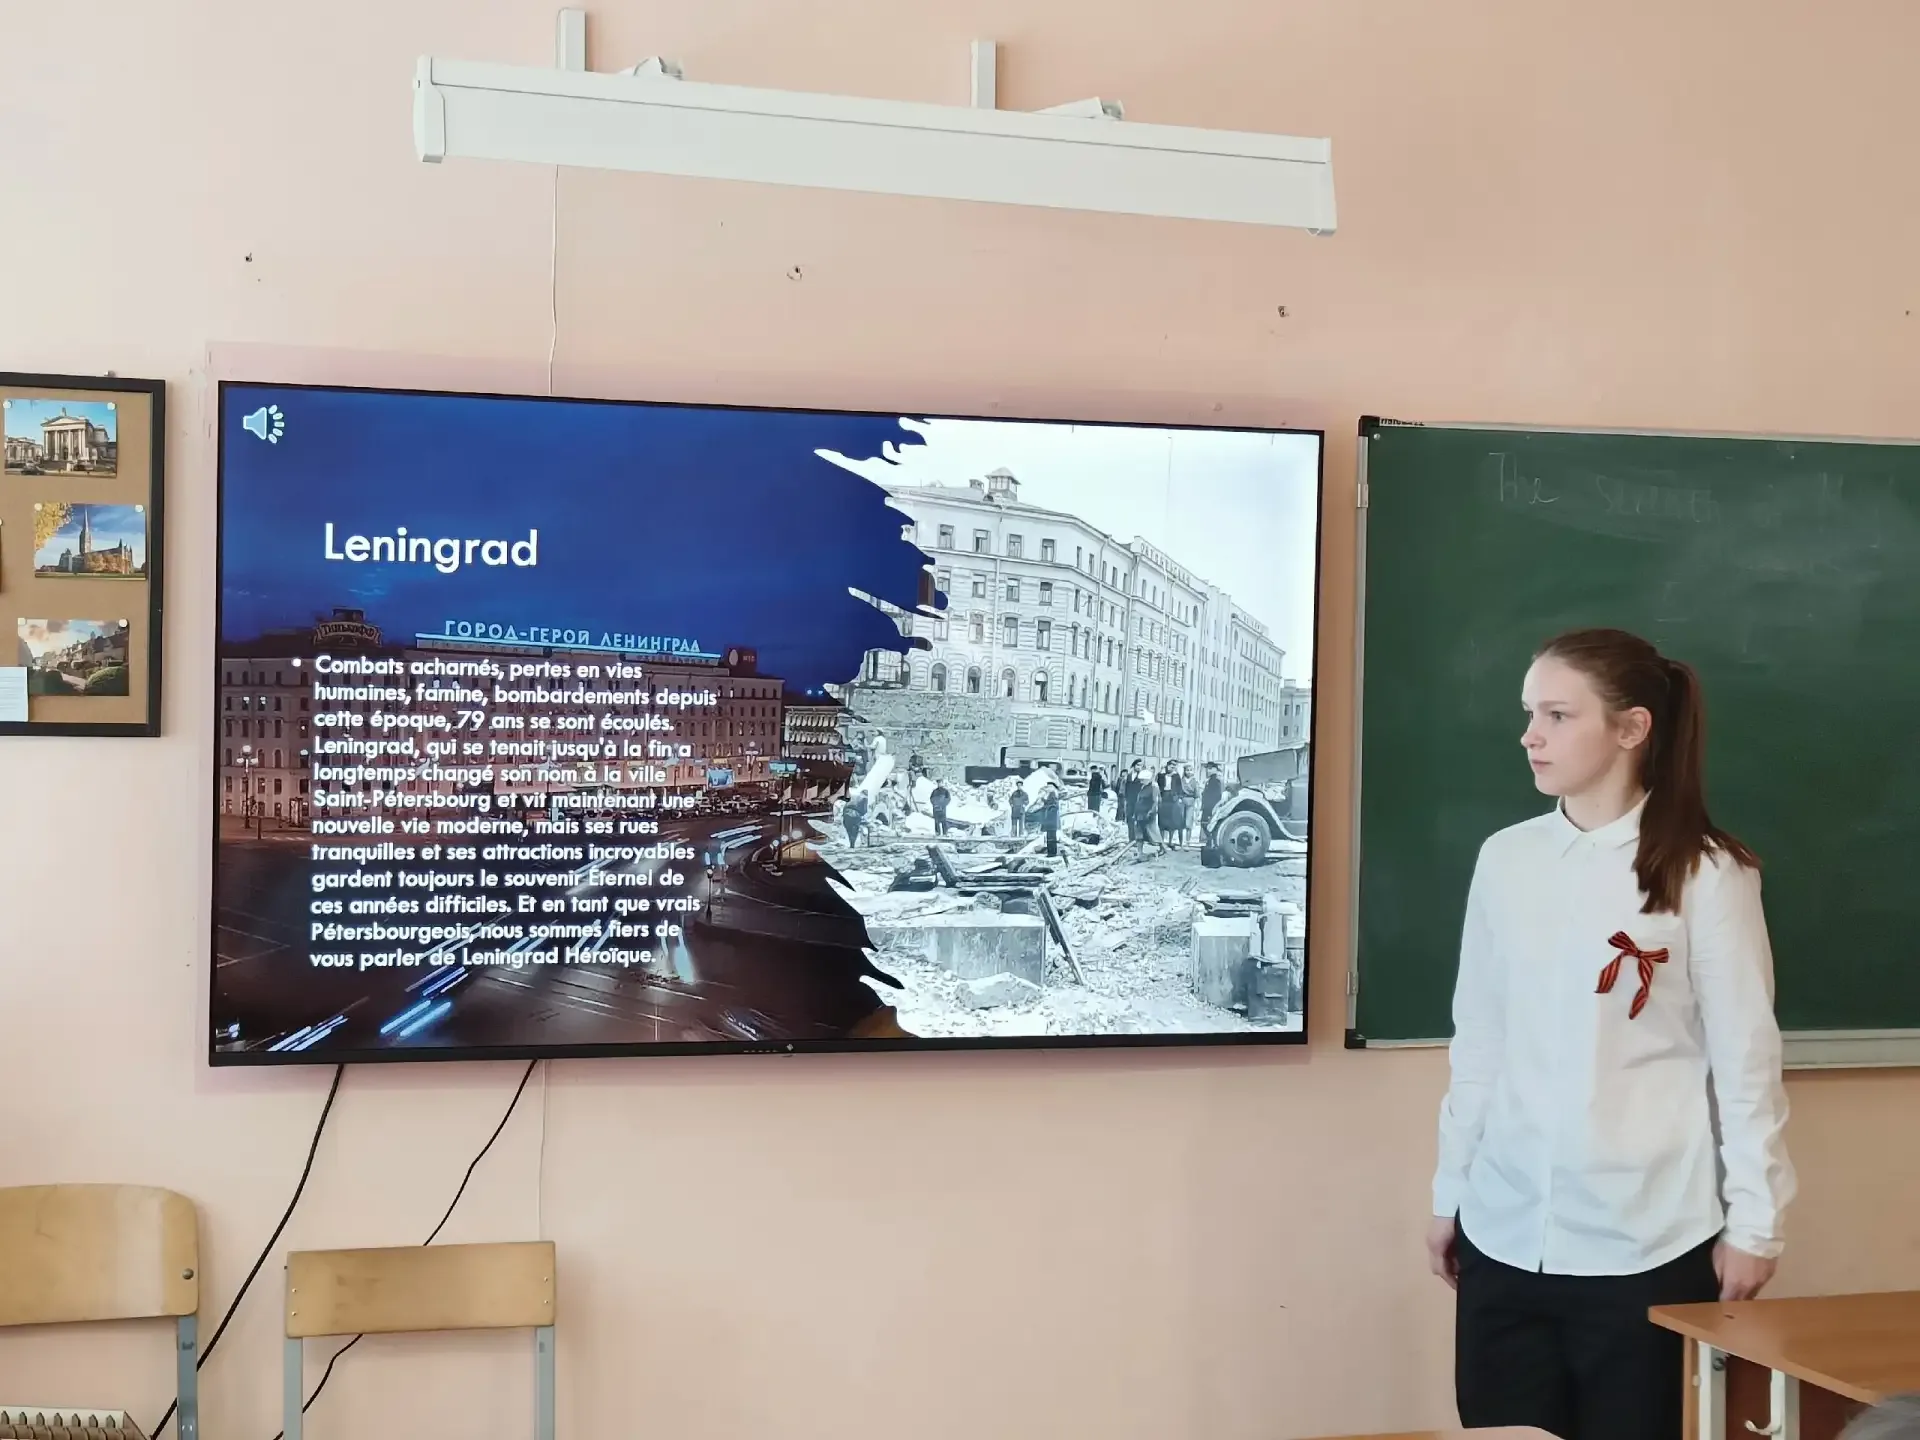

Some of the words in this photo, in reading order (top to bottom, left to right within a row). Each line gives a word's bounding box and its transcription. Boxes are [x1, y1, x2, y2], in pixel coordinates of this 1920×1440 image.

[324, 522, 538, 574] Leningrad
[444, 620, 590, 646] ГОРОД-ГЕРОЙ
[600, 632, 701, 653] ЛЕНИНГРАД
[315, 655, 404, 674] Combats
[411, 657, 504, 680] acharnés,
[510, 661, 571, 681] pertes
[577, 665, 600, 678] en
[606, 663, 642, 679] vies
[314, 682, 411, 705] humaines,
[416, 683, 488, 706] famine,
[494, 686, 650, 705] bombardements
[656, 688, 717, 710] depuis
[313, 711, 363, 727] cette
[370, 711, 451, 732] époque,
[456, 711, 485, 729] 79
[491, 715, 524, 729] ans
[530, 716, 551, 730] se
[557, 714, 595, 730] sont
[601, 713, 675, 731] écoulés.
[314, 736, 420, 759] Leningrad,
[427, 739, 457, 759] qui
[463, 742, 483, 755] se
[489, 740, 546, 756] tenait
[551, 737, 617, 760] jusqu'à
[624, 740, 641, 756] la
[648, 740, 672, 756] fin
[679, 744, 691, 757] a
[313, 763, 416, 785] longtemps
[422, 764, 494, 786] changé
[500, 768, 531, 781] son
[538, 768, 577, 782] nom
[584, 766, 596, 782] à
[604, 765, 621, 782] la
[628, 766, 667, 782] ville
[313, 790, 491, 812] Saint-Pétersbourg
[497, 793, 517, 807] et
[522, 792, 547, 808] vit
[552, 793, 656, 808] maintenant
[662, 795, 695, 808] une
[312, 816, 394, 834] nouvelle
[400, 817, 430, 833] vie
[437, 817, 529, 837] moderne,
[536, 818, 579, 834] mais
[585, 821, 613, 834] ses
[620, 821, 658, 834] rues
[311, 842, 415, 865] tranquilles
[421, 845, 442, 860] et
[447, 847, 476, 860] ses
[483, 844, 583, 860] attractions
[589, 842, 695, 863] incroyables
[311, 869, 393, 892] gardent
[398, 870, 474, 891] toujours
[480, 869, 498, 887] le
[504, 870, 581, 886] souvenir
[589, 865, 652, 886] Éternel
[660, 869, 684, 885] de
[310, 901, 343, 914] ces
[349, 897, 419, 914] années
[426, 896, 511, 913] difficiles.
[519, 895, 537, 912] Et
[542, 899, 565, 912] en
[572, 897, 609, 912] tant
[615, 899, 650, 916] que
[656, 896, 700, 912] vrais
[311, 922, 474, 944] Pétersbourgeois,
[480, 925, 523, 938] nous
[529, 924, 602, 938] sommes
[609, 920, 649, 938] fiers
[655, 920, 681, 938] de
[309, 953, 353, 967] vous
[359, 949, 421, 971] parler
[429, 948, 456, 966] de
[463, 947, 558, 968] Leningrad
[565, 947, 656, 968] Héroïque.
